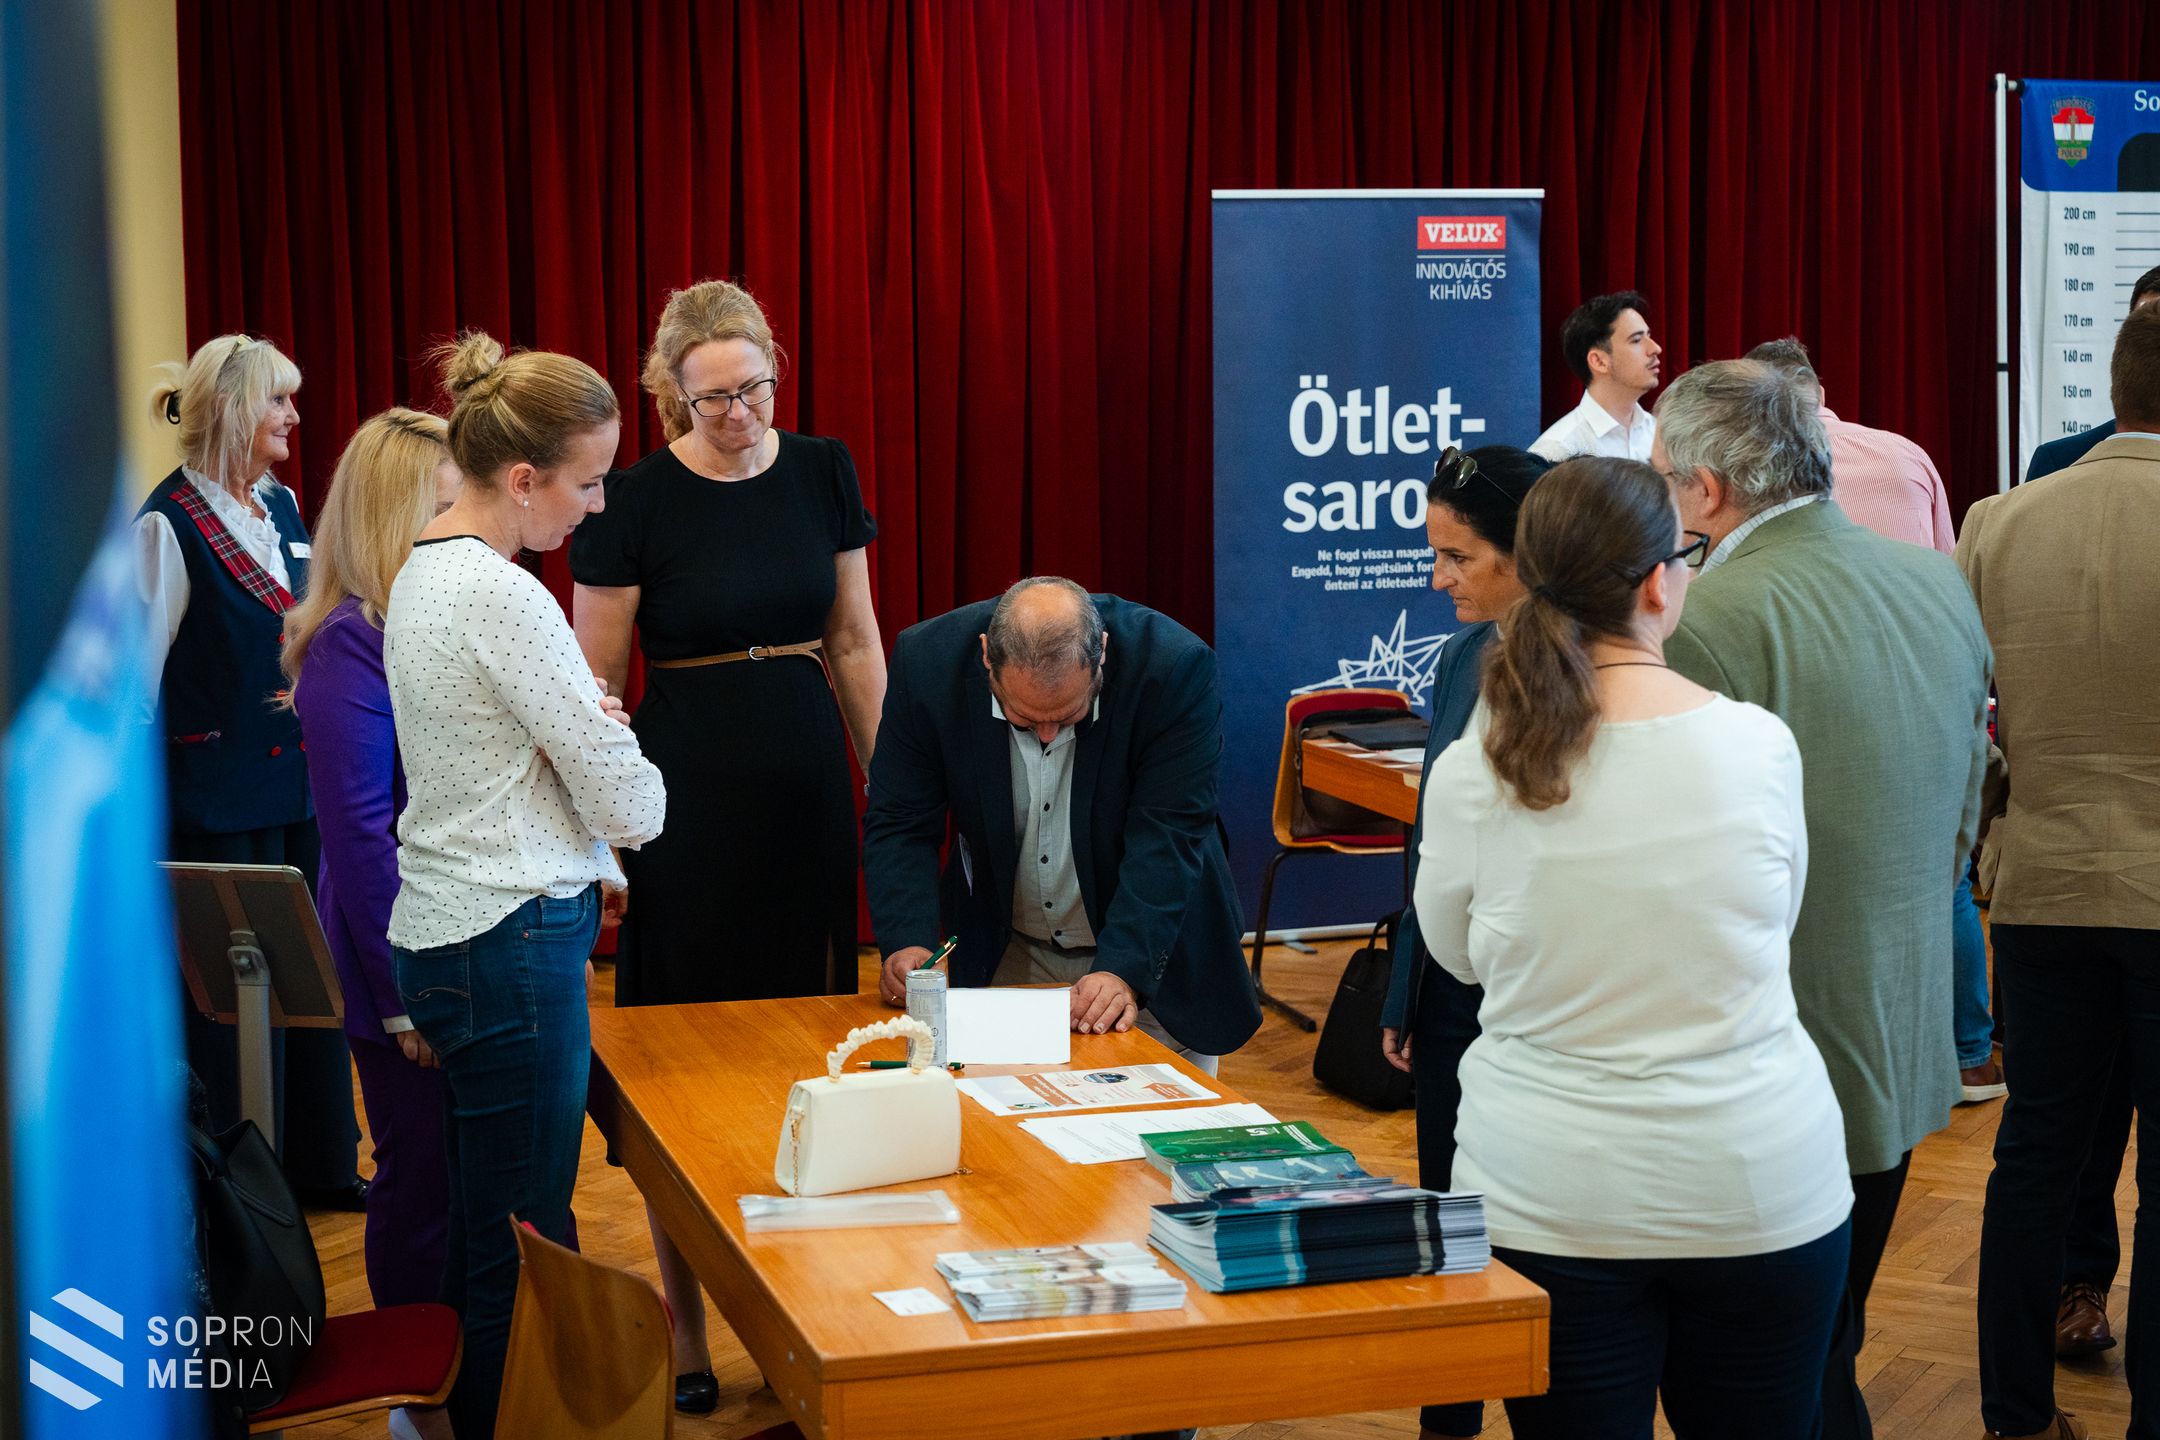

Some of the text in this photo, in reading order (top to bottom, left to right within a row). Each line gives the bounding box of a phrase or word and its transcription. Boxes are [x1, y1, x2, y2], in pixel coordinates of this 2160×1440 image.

[2064, 207, 2096, 220] 200 cm
[1424, 223, 1499, 243] VELUX
[2064, 243, 2095, 256] 190 cm
[1415, 258, 1507, 280] INNOVÁCIÓS
[1429, 280, 1492, 300] KIHÍVÁS
[2064, 279, 2094, 292] 180 cm
[2064, 314, 2093, 327] 170 cm
[2063, 350, 2093, 362] 160 cm
[2063, 385, 2092, 398] 150 cm
[1289, 375, 1486, 457] Ötlet-
[2062, 421, 2092, 433] 140 cm
[1282, 462, 1439, 533] saro
[1318, 550, 1332, 561] Ne
[1335, 548, 1360, 562] fogd
[1362, 548, 1394, 560] vissza
[1291, 565, 1333, 579] Engedd,
[1335, 564, 1361, 577] hogy
[1324, 576, 1428, 591] önteni az ötletedet!
